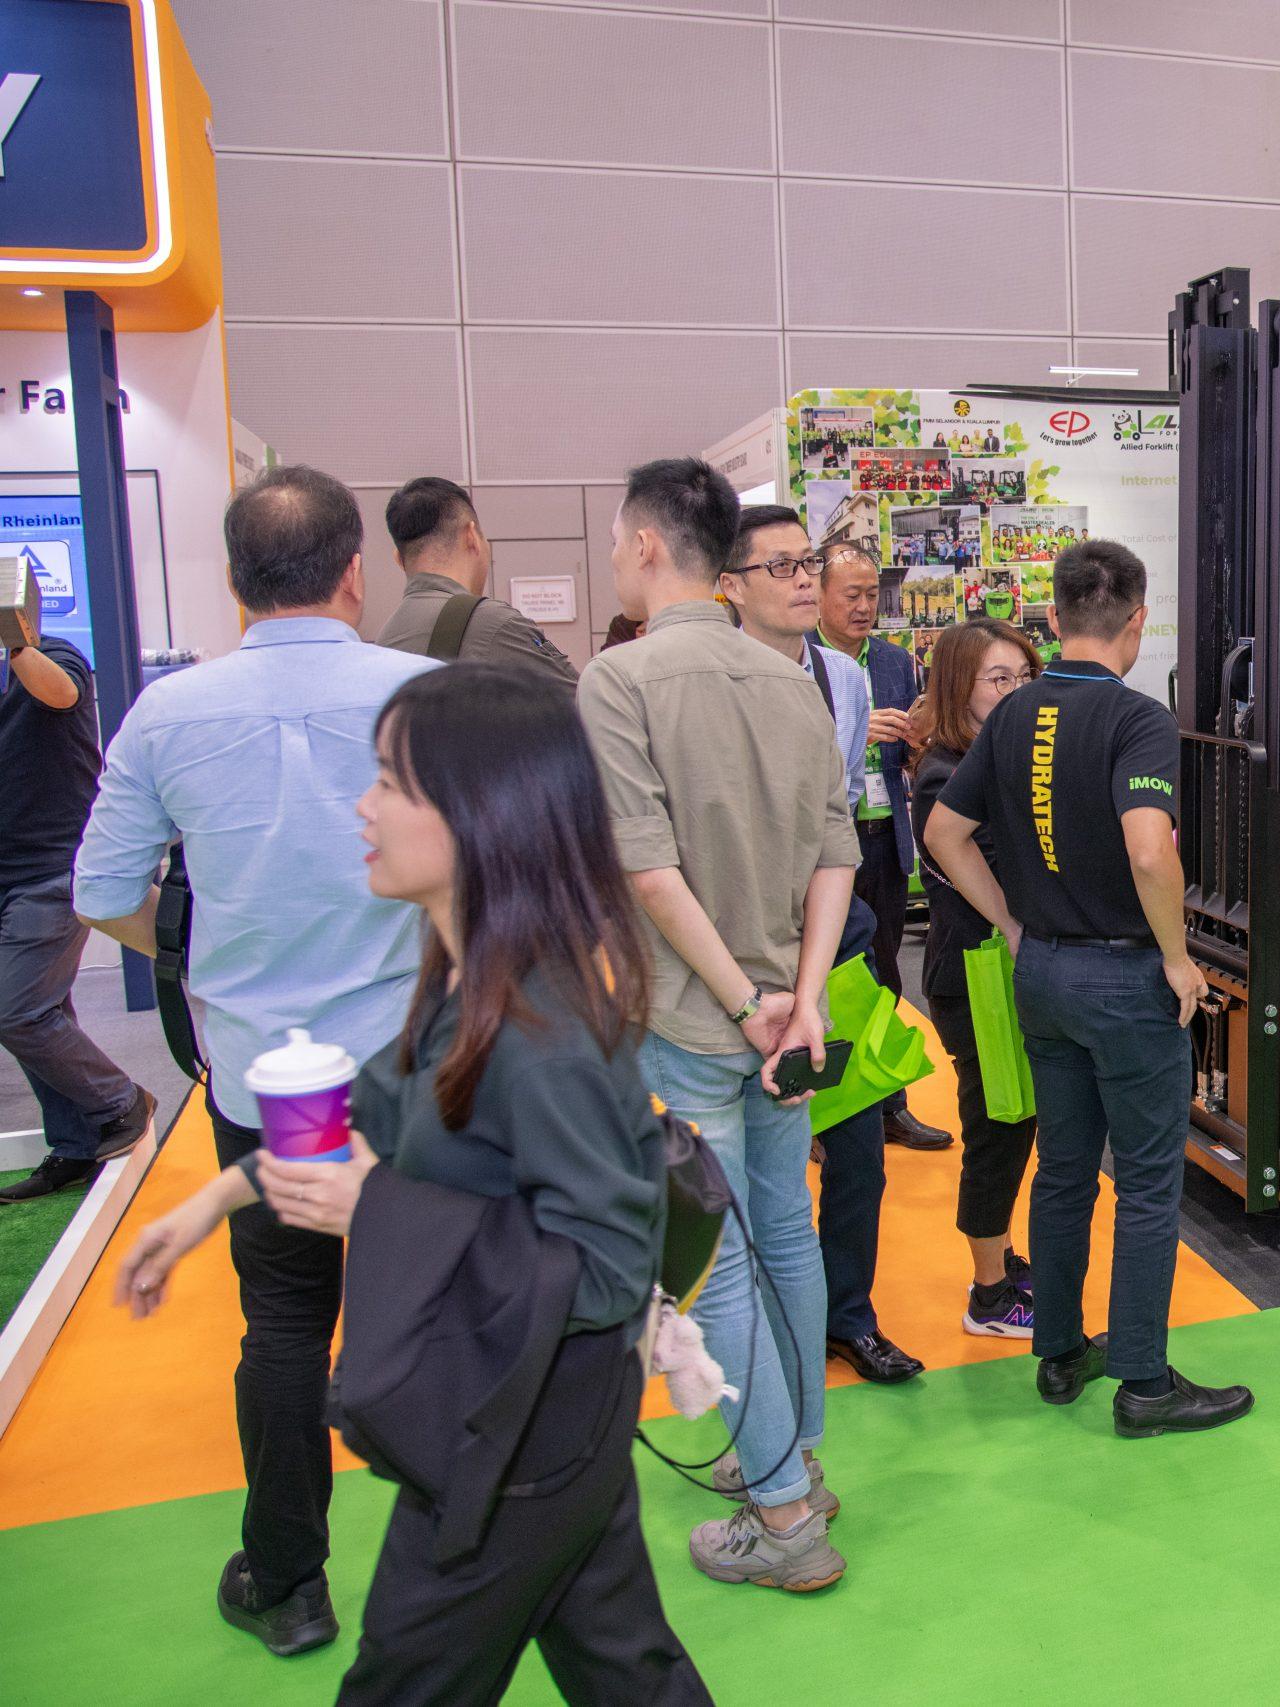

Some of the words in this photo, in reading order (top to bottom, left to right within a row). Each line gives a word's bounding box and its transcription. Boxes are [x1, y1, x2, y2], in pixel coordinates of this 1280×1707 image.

[1050, 410, 1091, 438] EP
[1144, 414, 1179, 429] AL
[1039, 431, 1055, 444] Let's
[1055, 438, 1071, 447] grow
[1071, 431, 1098, 447] together
[1120, 443, 1143, 451] Allied
[1145, 443, 1174, 451] Forklift
[1121, 475, 1178, 487] Internet
[3, 513, 81, 528] Rheinlan
[1122, 534, 1144, 543] Total
[40, 584, 67, 593] nland
[42, 599, 59, 608] IED
[1031, 706, 1060, 873] HYDRATECH
[1129, 776, 1173, 797] iMOW
